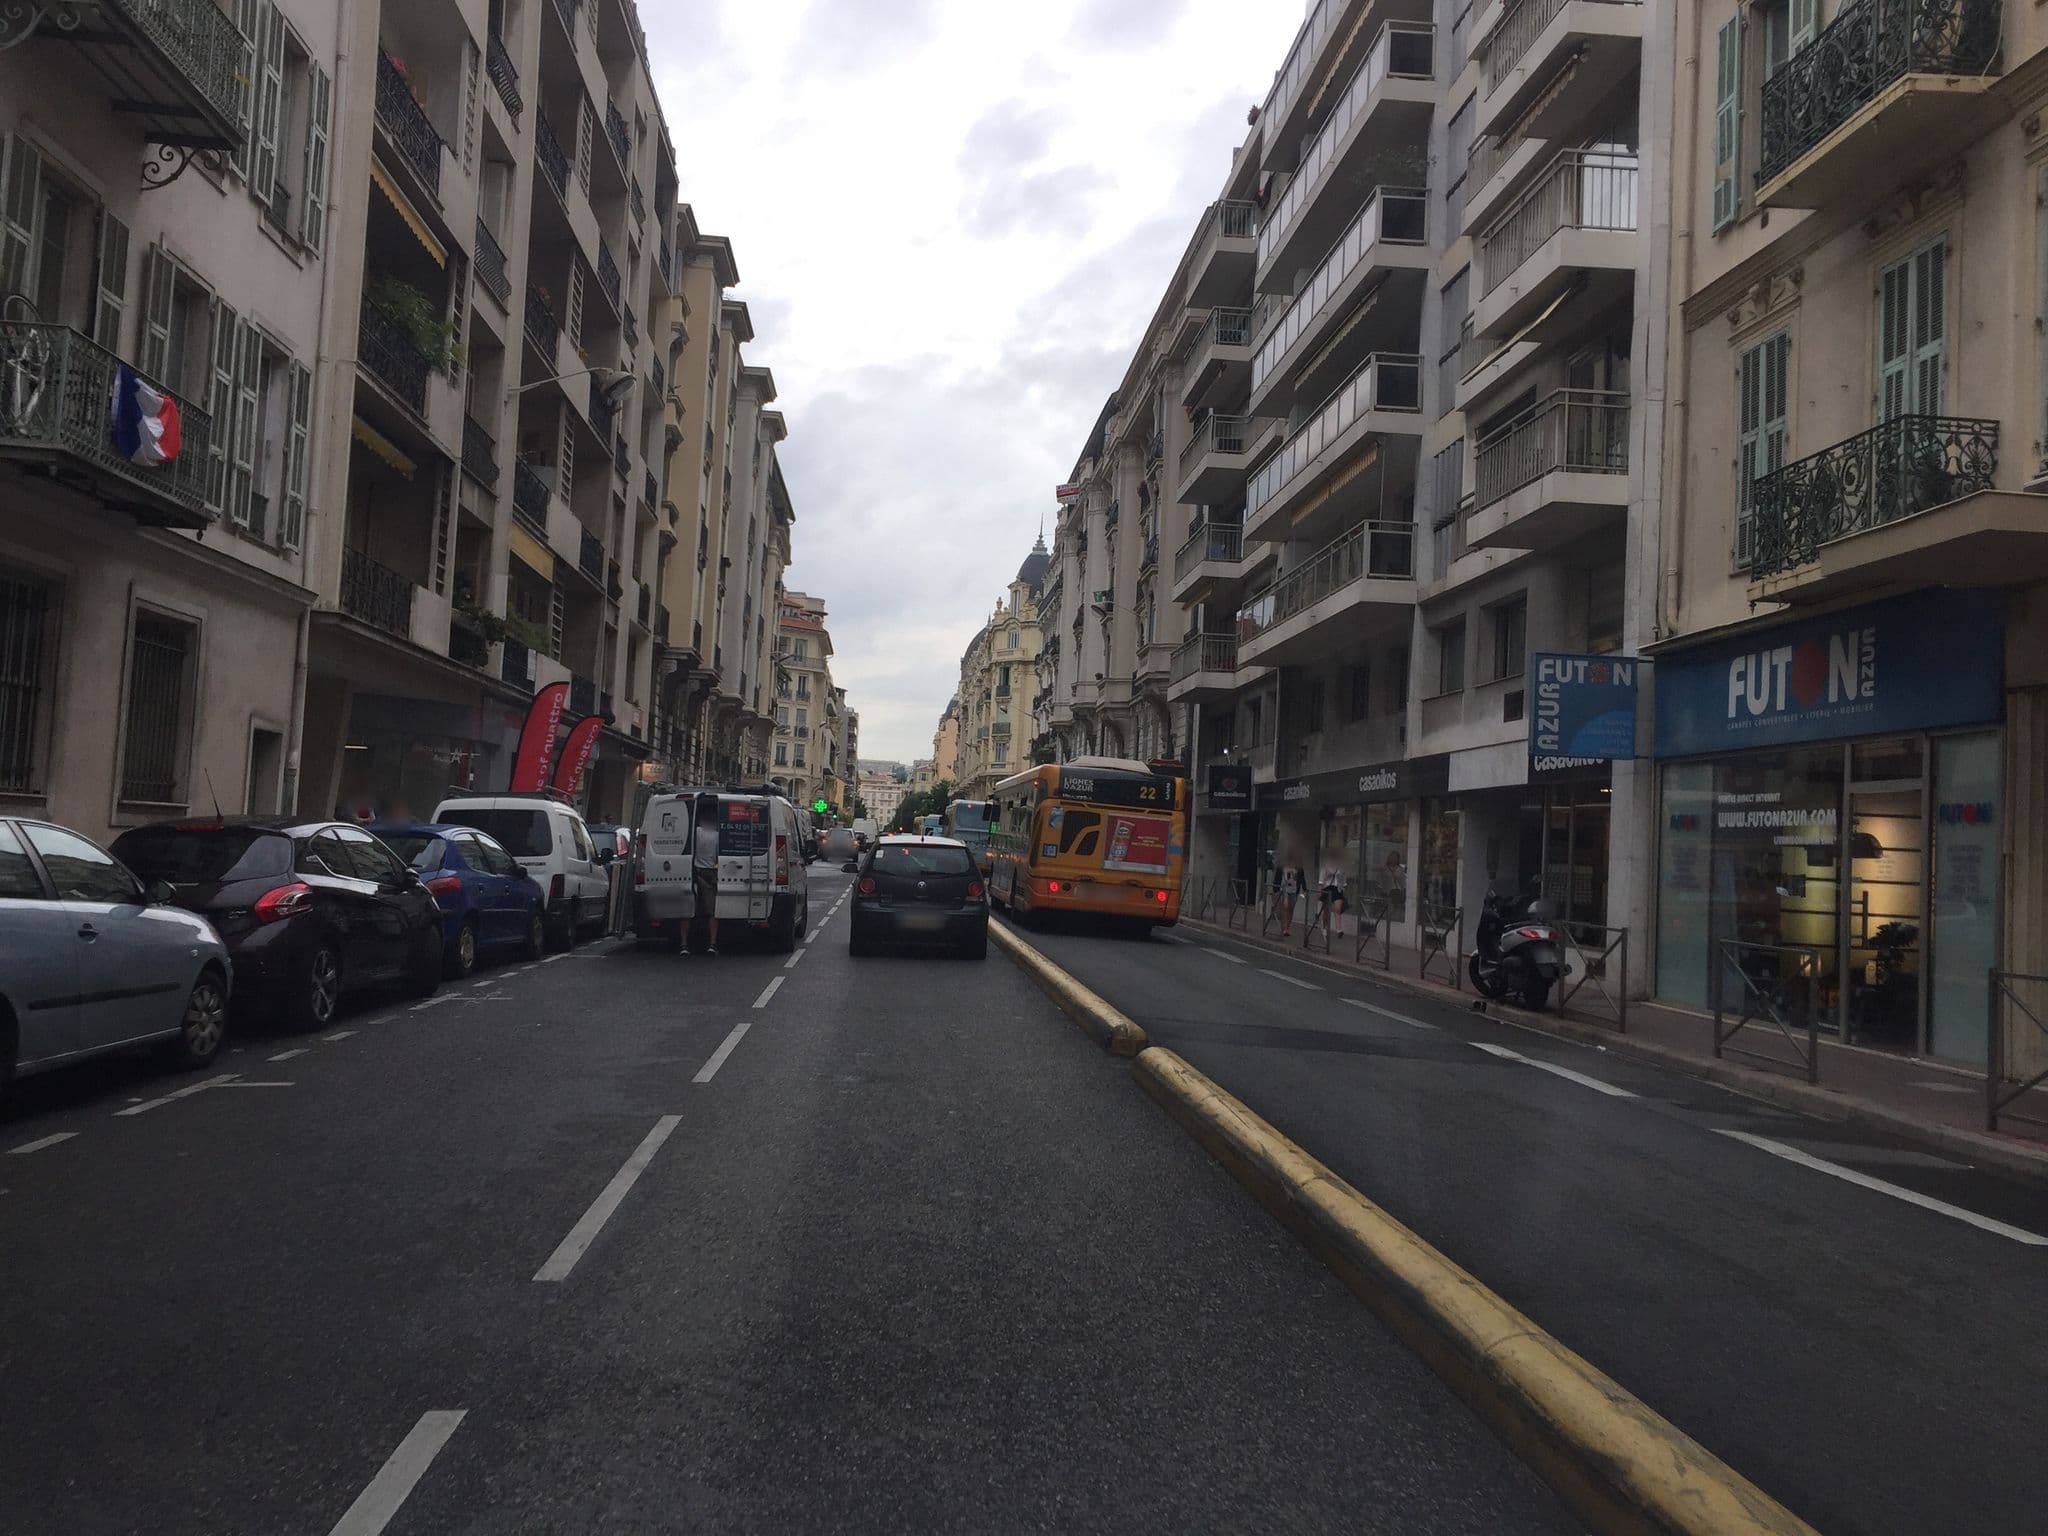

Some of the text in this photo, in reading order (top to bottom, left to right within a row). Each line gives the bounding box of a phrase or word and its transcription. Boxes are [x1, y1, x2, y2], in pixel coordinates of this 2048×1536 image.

[1539, 658, 1632, 687] FUTON
[1728, 633, 1859, 718] FUTON
[1861, 626, 1876, 697] AZUR
[543, 692, 564, 754] quattro
[1537, 682, 1560, 750] AZUR
[575, 724, 599, 774] quattro
[1139, 786, 1157, 800] 22
[1358, 767, 1397, 792] casaoikos
